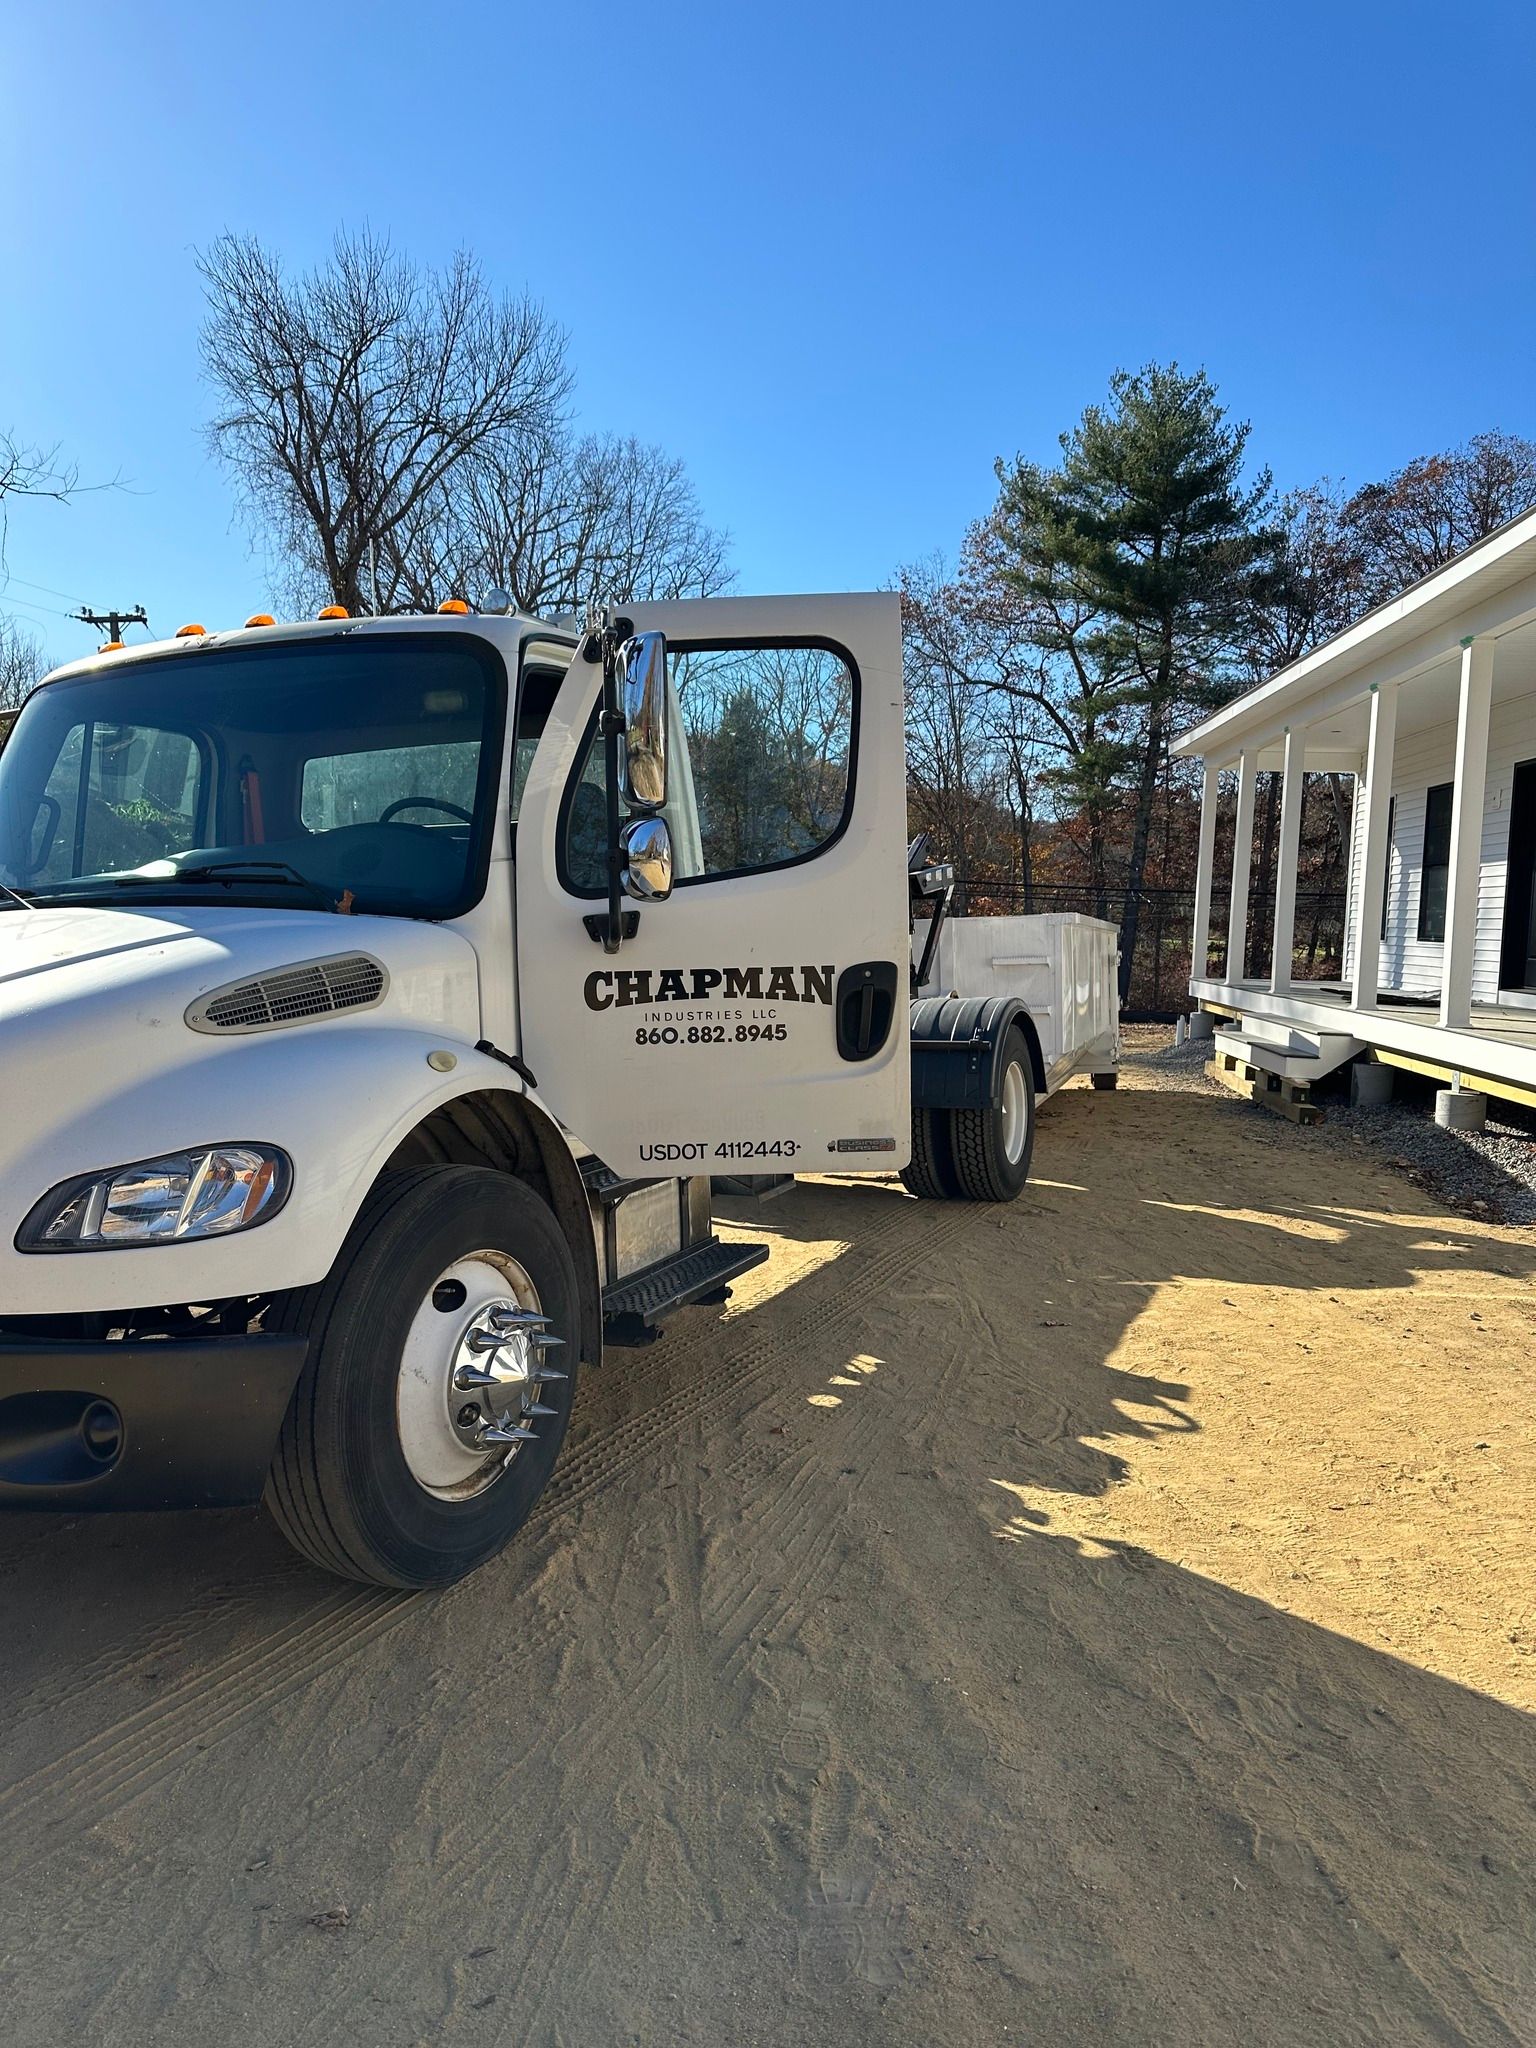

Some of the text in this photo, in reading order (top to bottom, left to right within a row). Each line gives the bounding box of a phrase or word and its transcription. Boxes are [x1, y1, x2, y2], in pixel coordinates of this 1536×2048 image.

[584, 965, 836, 1012] CHAPMAN
[644, 1009, 777, 1022] INDUSTRIES LLC
[635, 1023, 788, 1046] 860.882.8945
[639, 1143, 708, 1161] USDOT
